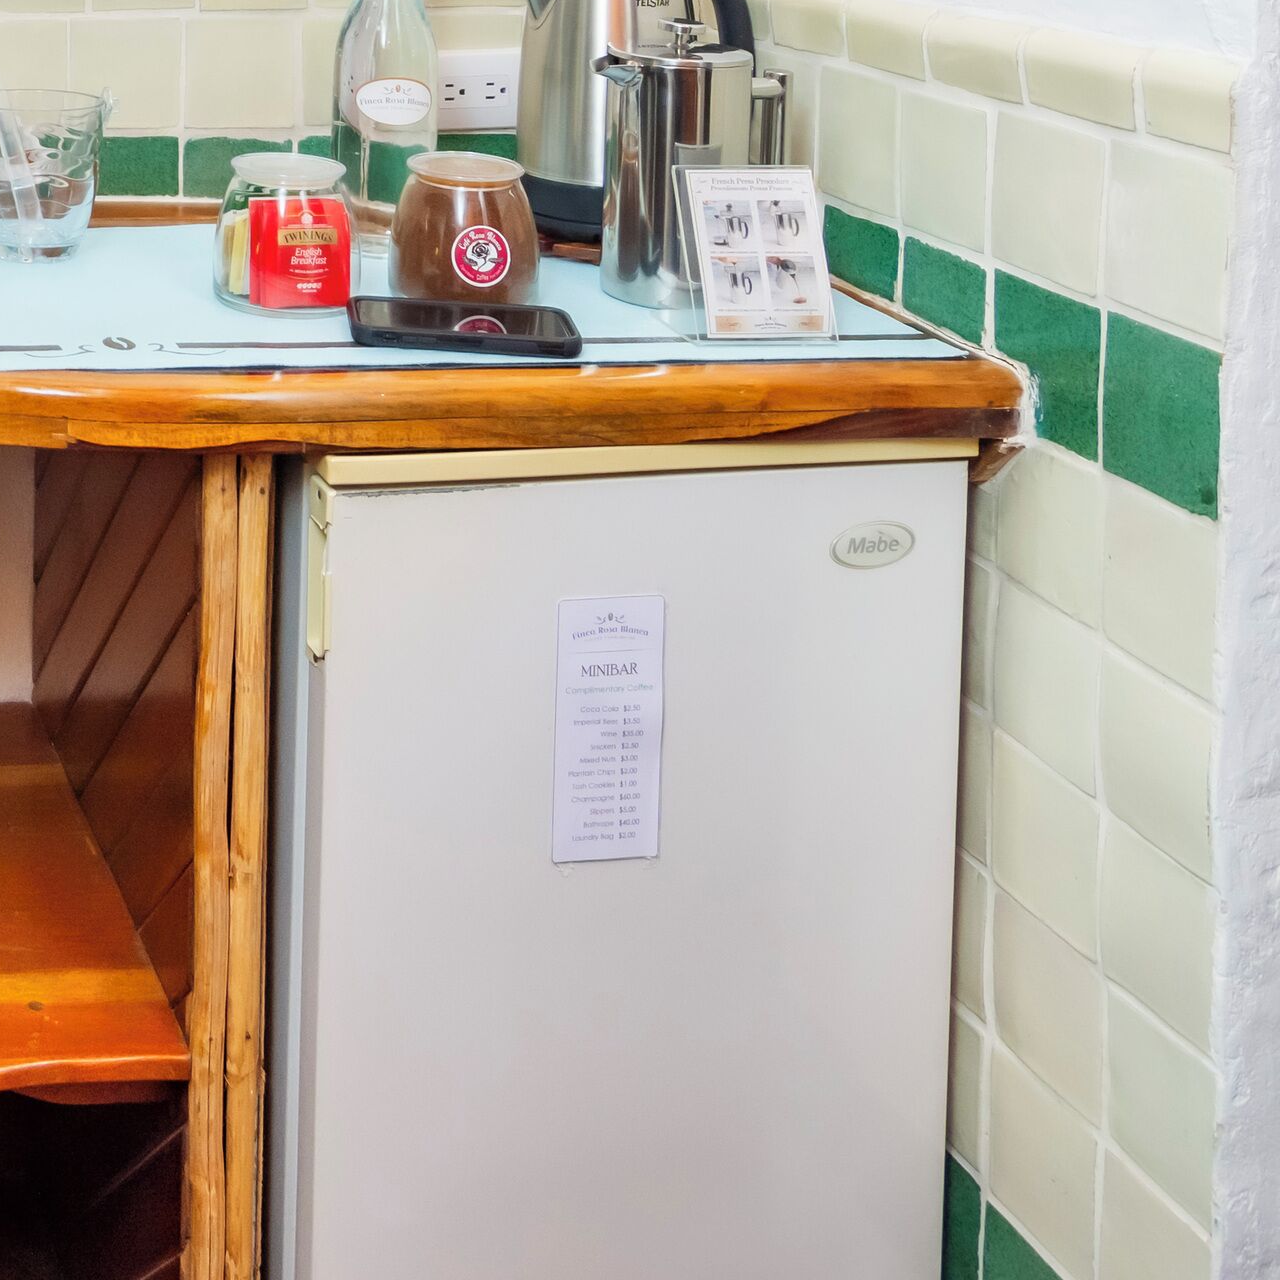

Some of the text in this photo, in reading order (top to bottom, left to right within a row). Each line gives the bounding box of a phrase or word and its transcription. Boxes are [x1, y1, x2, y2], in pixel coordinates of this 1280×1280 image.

[284, 230, 334, 243] TWININGS
[295, 247, 322, 258] English
[290, 256, 328, 266] Breakfast
[847, 536, 900, 554] Mabe
[598, 626, 618, 634] Rosa
[620, 625, 649, 636] Blanca
[581, 662, 638, 677] MINIBAR
